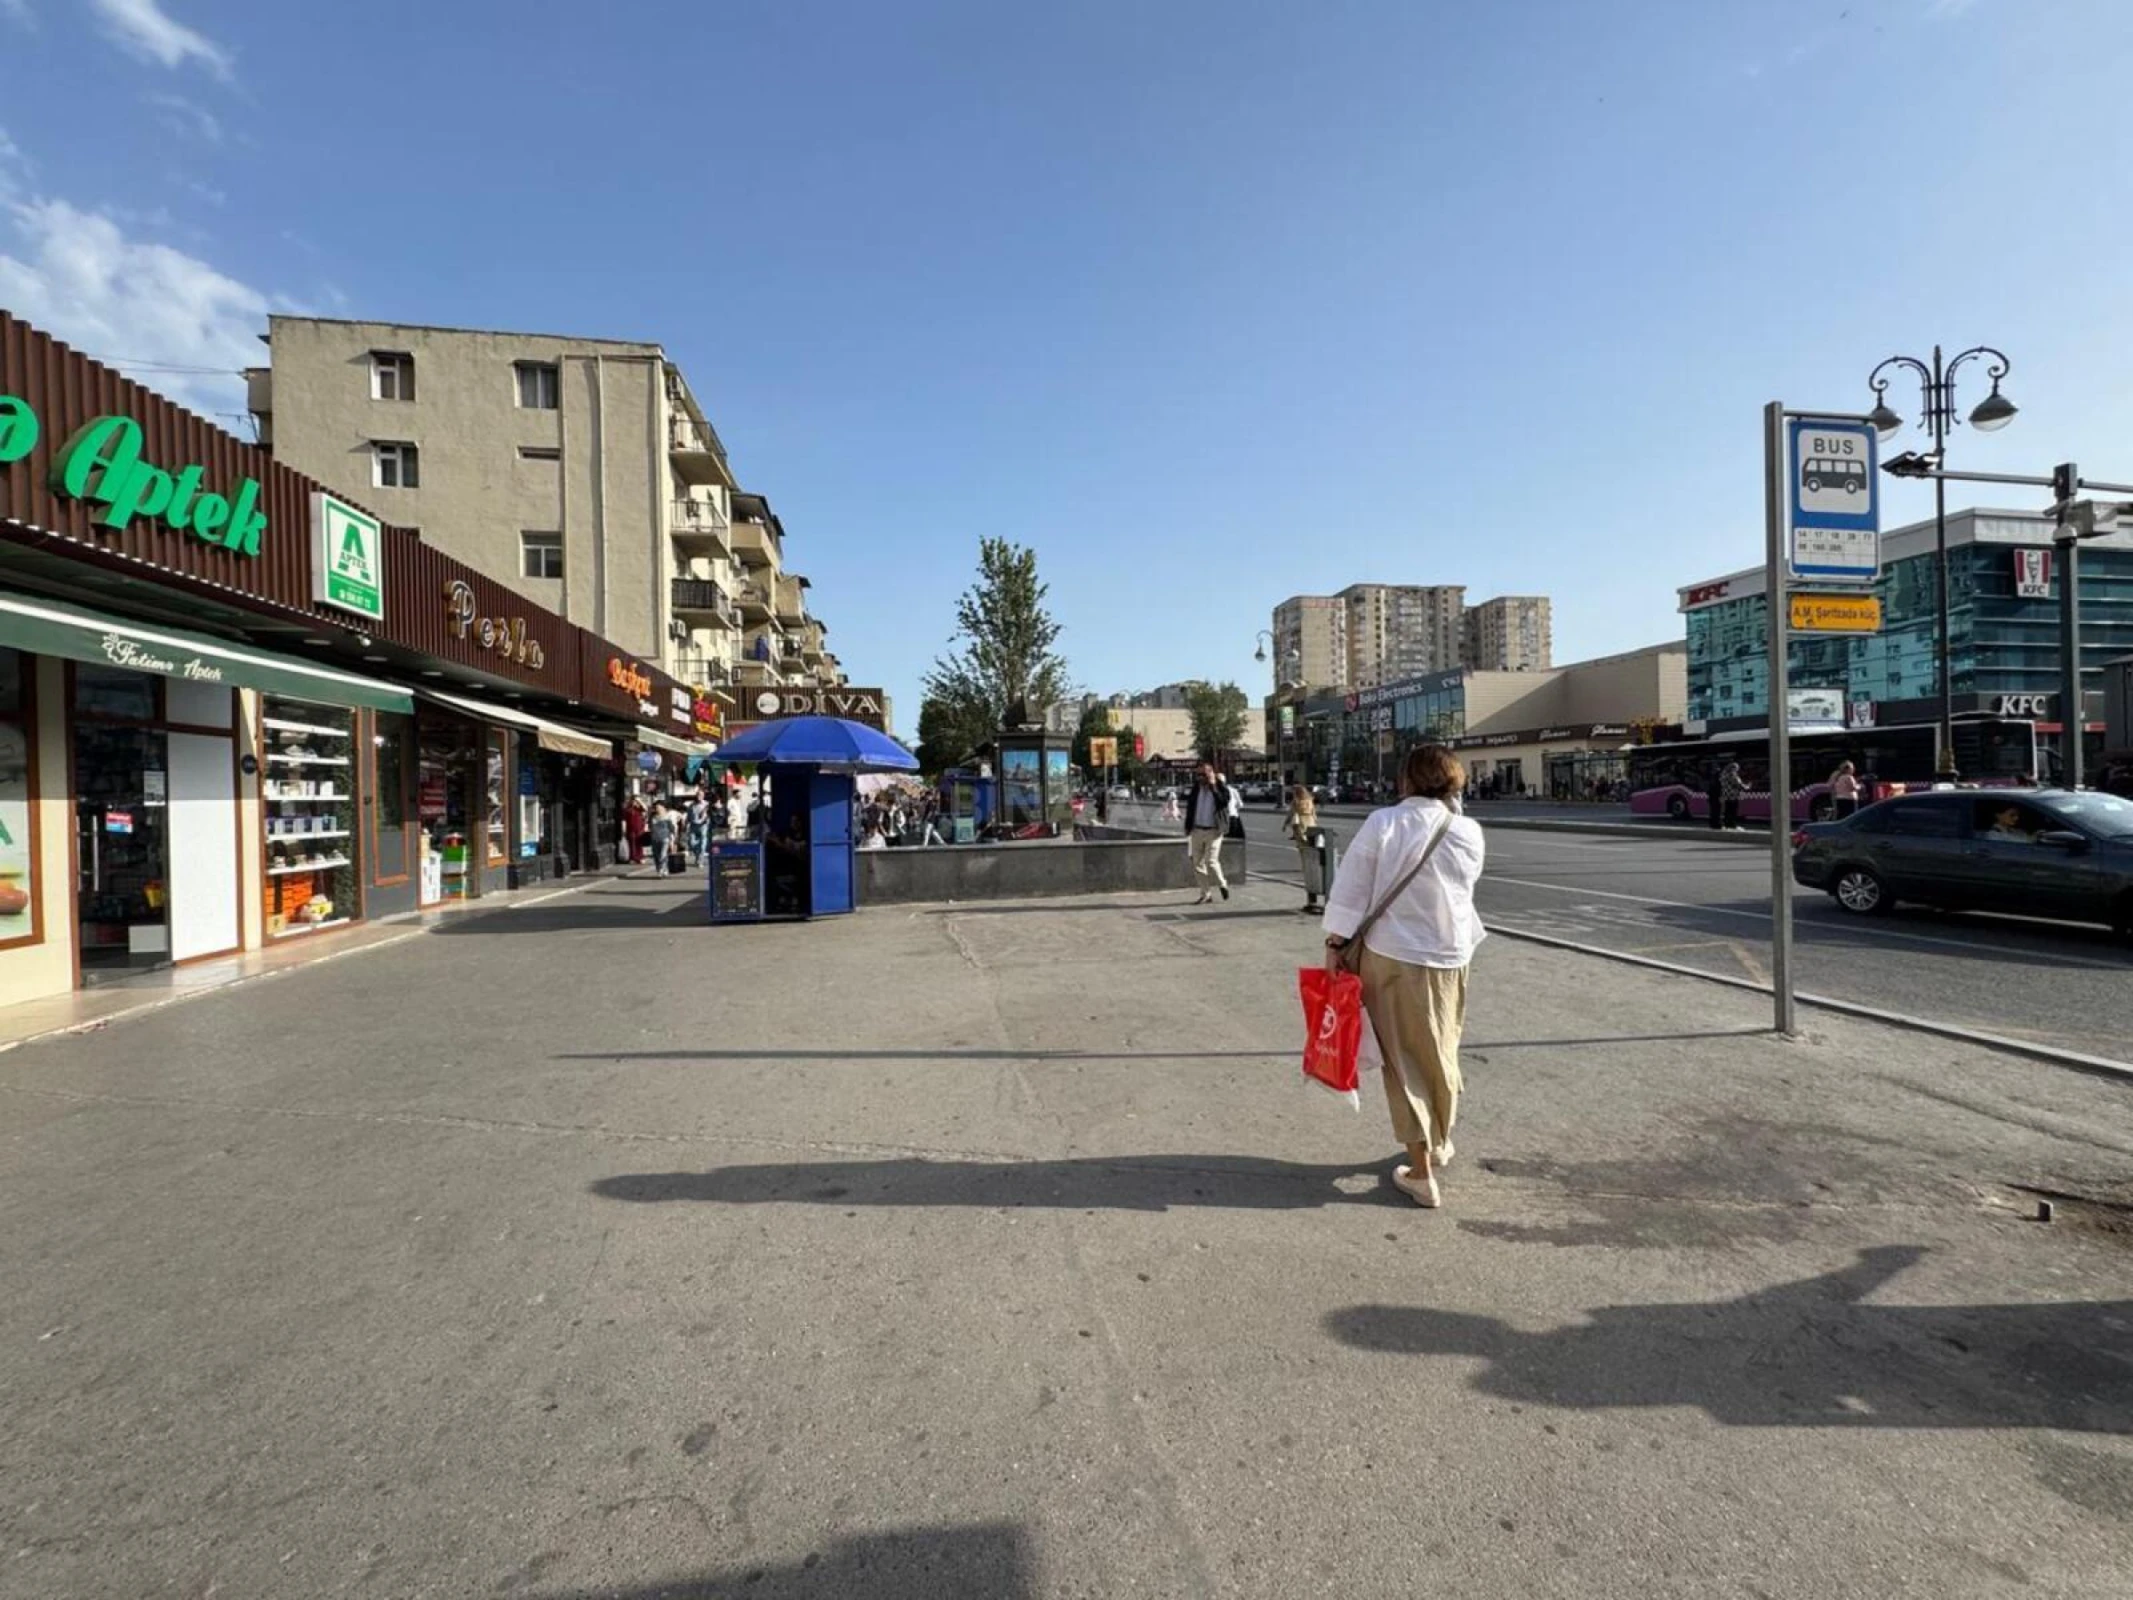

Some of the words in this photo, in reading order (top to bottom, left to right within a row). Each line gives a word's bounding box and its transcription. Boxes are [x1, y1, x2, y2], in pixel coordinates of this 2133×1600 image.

[1813, 437, 1854, 454] BUS
[62, 415, 268, 557] Aptek
[1687, 581, 1728, 605] KFC
[2022, 584, 2045, 595] KFC
[448, 580, 545, 670] Perla
[782, 688, 881, 714] DİVA
[2000, 695, 2046, 715] KFC
